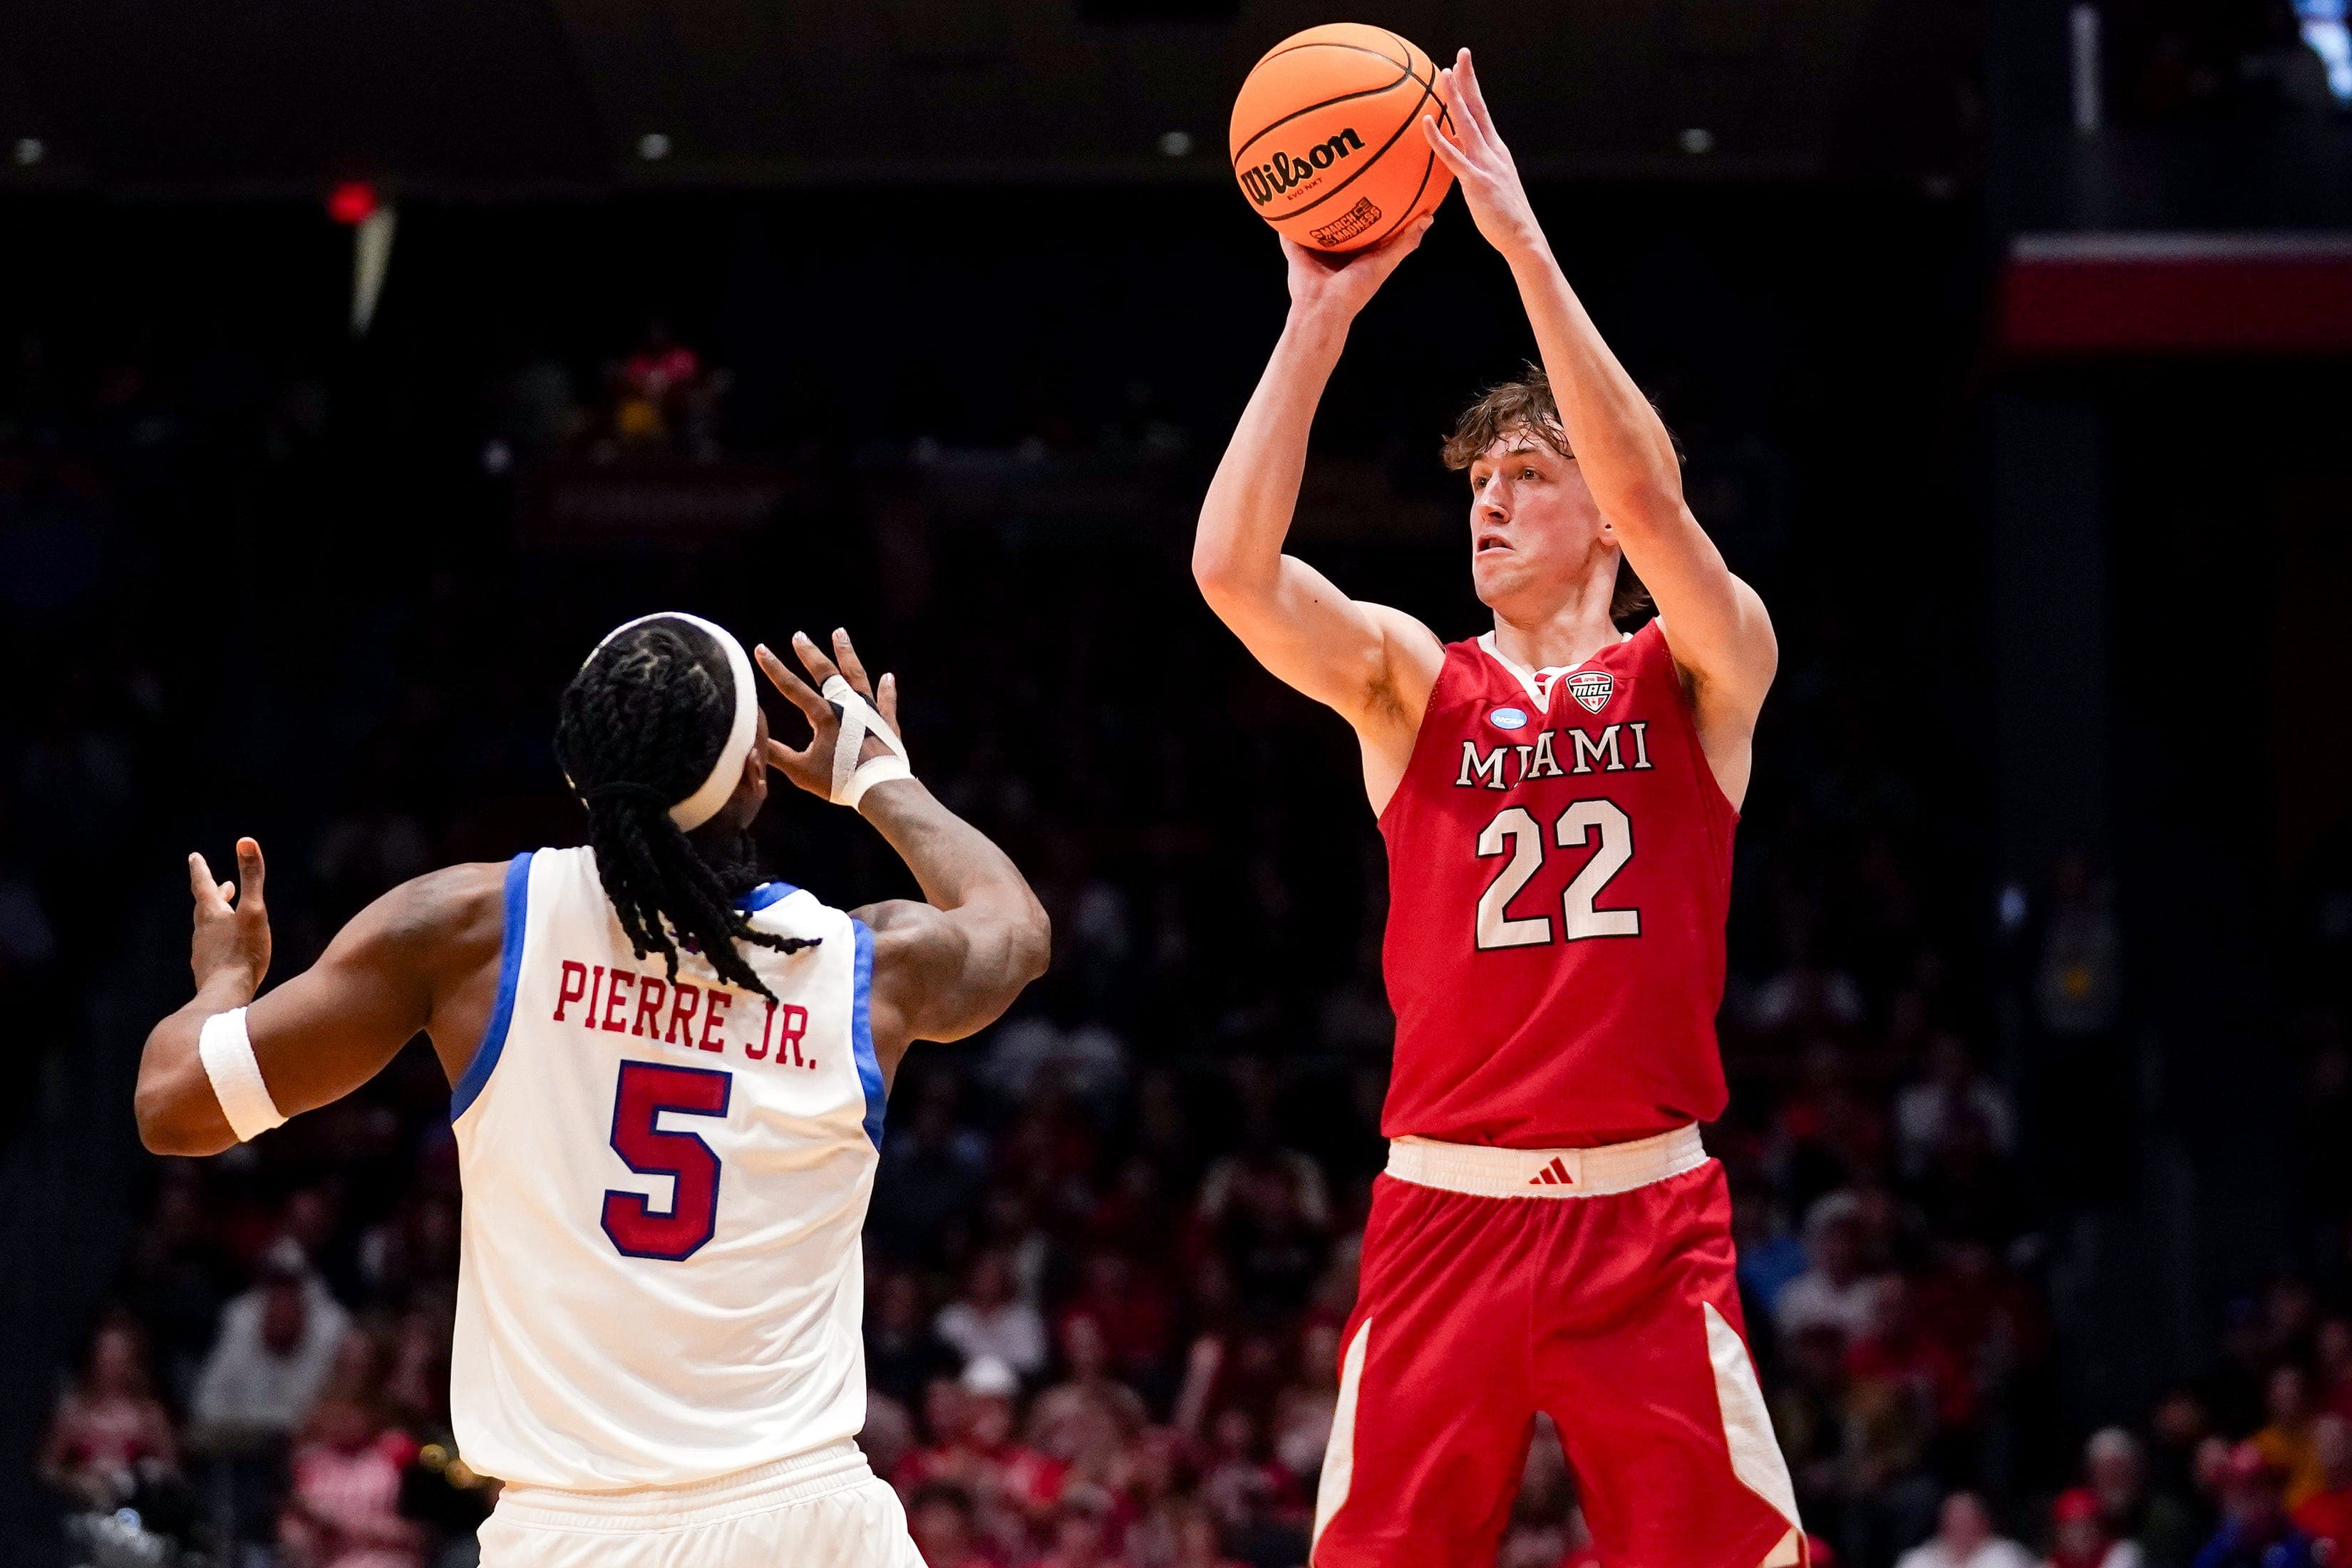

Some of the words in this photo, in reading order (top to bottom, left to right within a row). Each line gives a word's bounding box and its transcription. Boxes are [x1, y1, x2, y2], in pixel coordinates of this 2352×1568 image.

[1240, 128, 1366, 206] Wilson
[1319, 212, 1356, 239] MARCH
[1332, 206, 1380, 242] MADNESS
[1494, 715, 1525, 725] NCAA
[1573, 684, 1611, 696] MAC
[1455, 723, 1654, 789] MIAMI
[1477, 798, 1641, 950] 22
[553, 960, 732, 1053] PIERRE
[745, 1001, 816, 1069] JR.
[600, 1059, 733, 1262] 5
